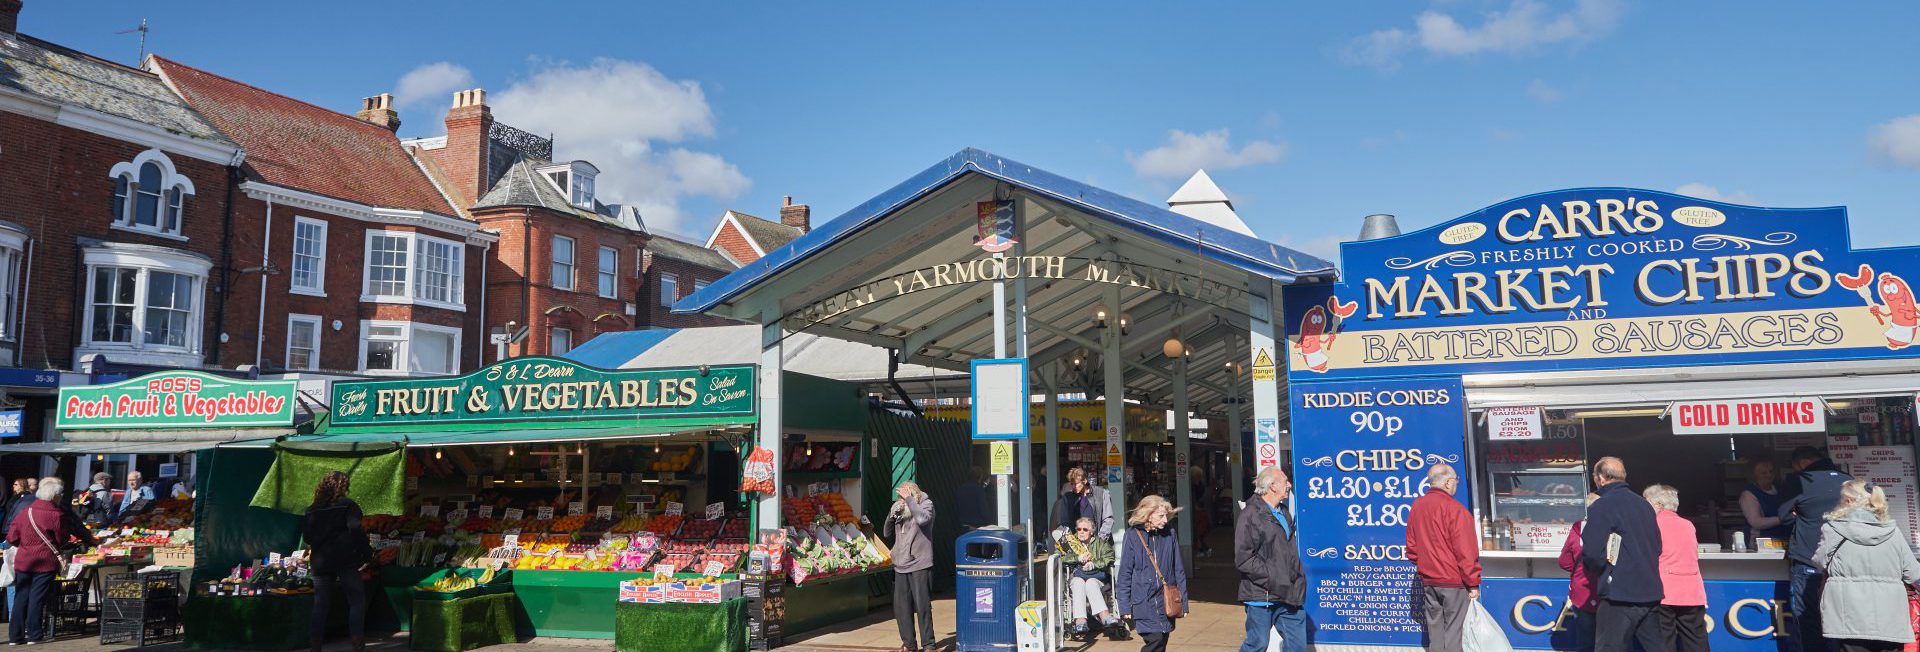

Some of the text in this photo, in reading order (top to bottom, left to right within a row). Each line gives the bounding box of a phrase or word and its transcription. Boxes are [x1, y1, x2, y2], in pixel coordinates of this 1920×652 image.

[1498, 197, 1665, 242] CARR'S
[1679, 207, 1718, 219] GLUTEN
[1685, 216, 1711, 226] FREE
[1444, 224, 1479, 238] GLUTEN
[1452, 232, 1475, 244] FREE
[1480, 238, 1684, 264] FRESHLY COOKED
[893, 255, 1066, 296] YARMOUTH
[1364, 249, 1831, 318] MARKET CHIPS
[1566, 308, 1607, 321] AND
[1362, 312, 1843, 364] BATTERED SAUSAGES
[34, 374, 55, 383] 35-36
[505, 365, 519, 380] &
[534, 364, 575, 379] Dearn
[148, 377, 202, 393] ROS'S
[709, 376, 737, 391] Salad
[340, 389, 368, 406] Fresh
[376, 377, 698, 415] FRUIT & VEGETABLES
[1303, 389, 1450, 409] KIDDIE CONES
[65, 391, 286, 423] Fresh Fruit & Vegetables
[1679, 402, 1815, 427] COLD DRINKS
[1350, 411, 1403, 437] 90p
[1542, 425, 1577, 439] 1.50
[1335, 449, 1425, 472] CHIPS
[1308, 476, 1431, 499] £1.30 £1.6
[1320, 623, 1358, 631] PICKLED
